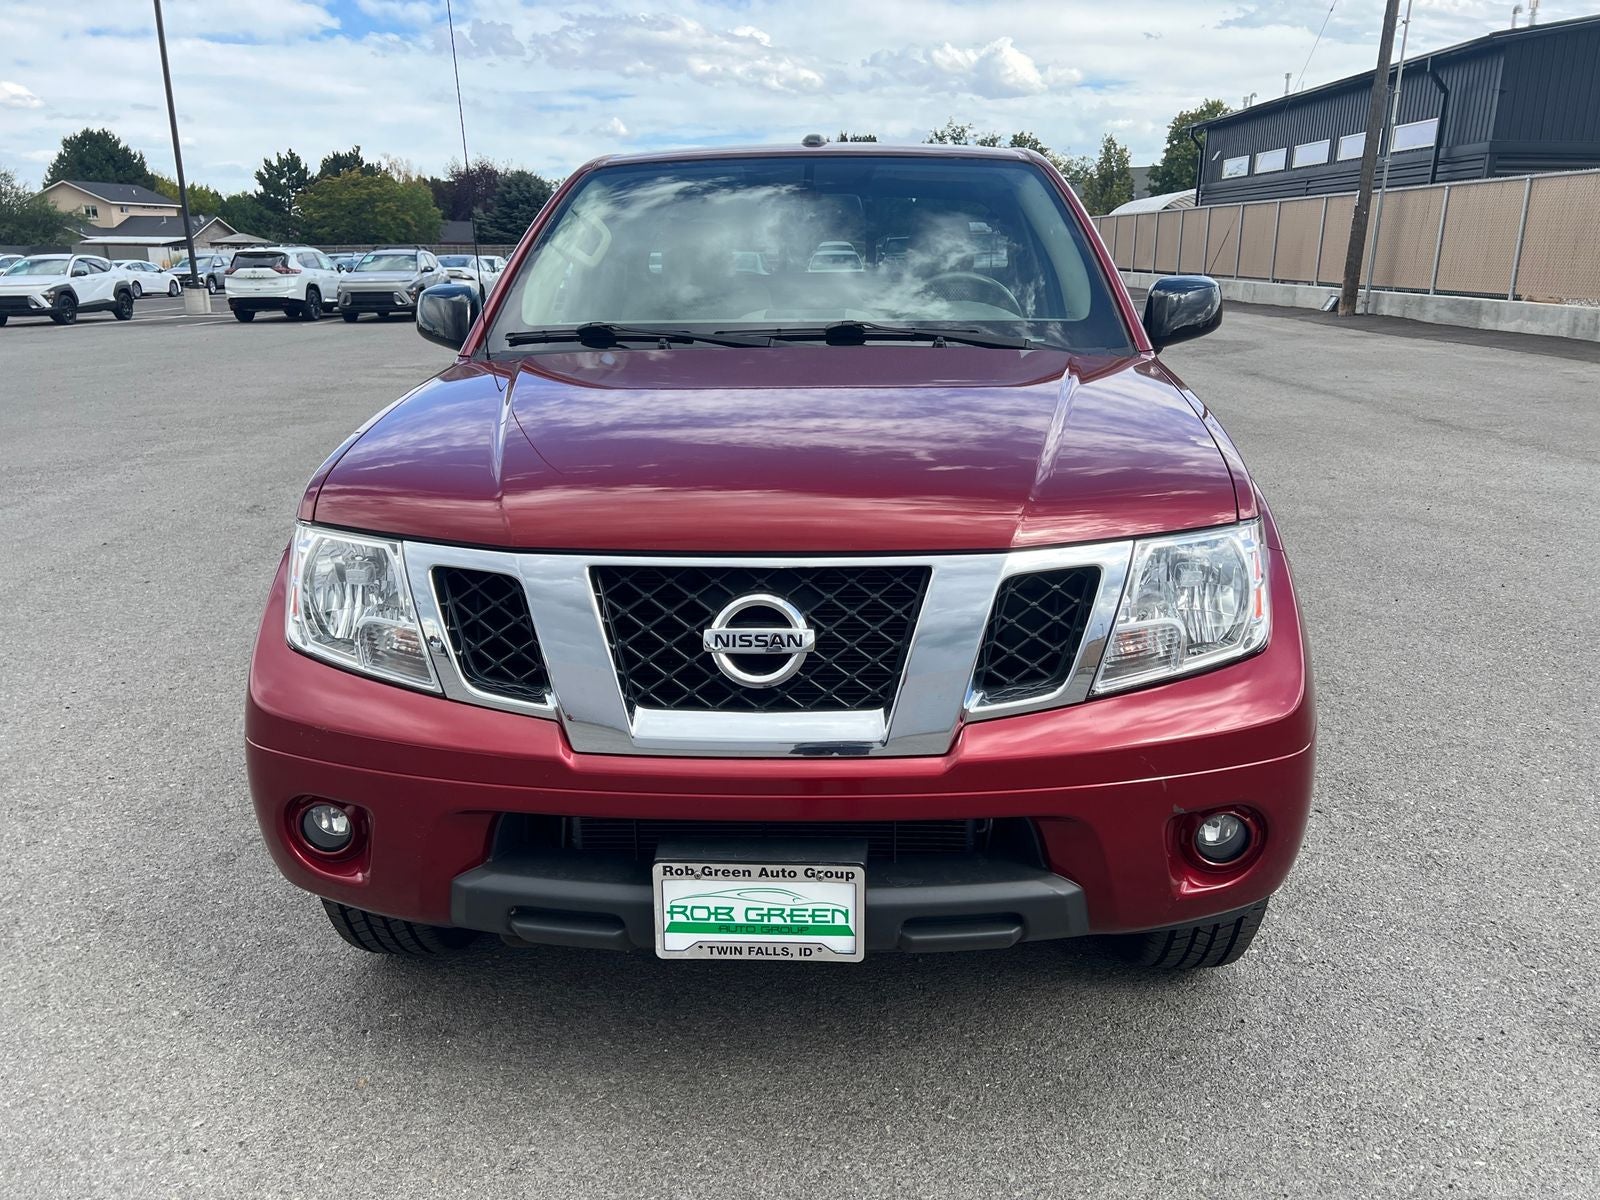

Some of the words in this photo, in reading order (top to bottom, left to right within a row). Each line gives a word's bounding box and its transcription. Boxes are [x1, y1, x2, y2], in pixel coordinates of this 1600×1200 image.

[714, 633, 803, 648] NISSAN
[662, 865, 695, 876] Rob
[701, 866, 752, 878] Green
[758, 867, 798, 878] Auto
[666, 905, 735, 922] ROB
[744, 907, 849, 924] GREEN
[718, 925, 756, 933] AUTO
[760, 926, 809, 934] GROUP
[707, 946, 743, 956] TWIN
[748, 946, 794, 958] FALLS,
[798, 947, 813, 957] ID
